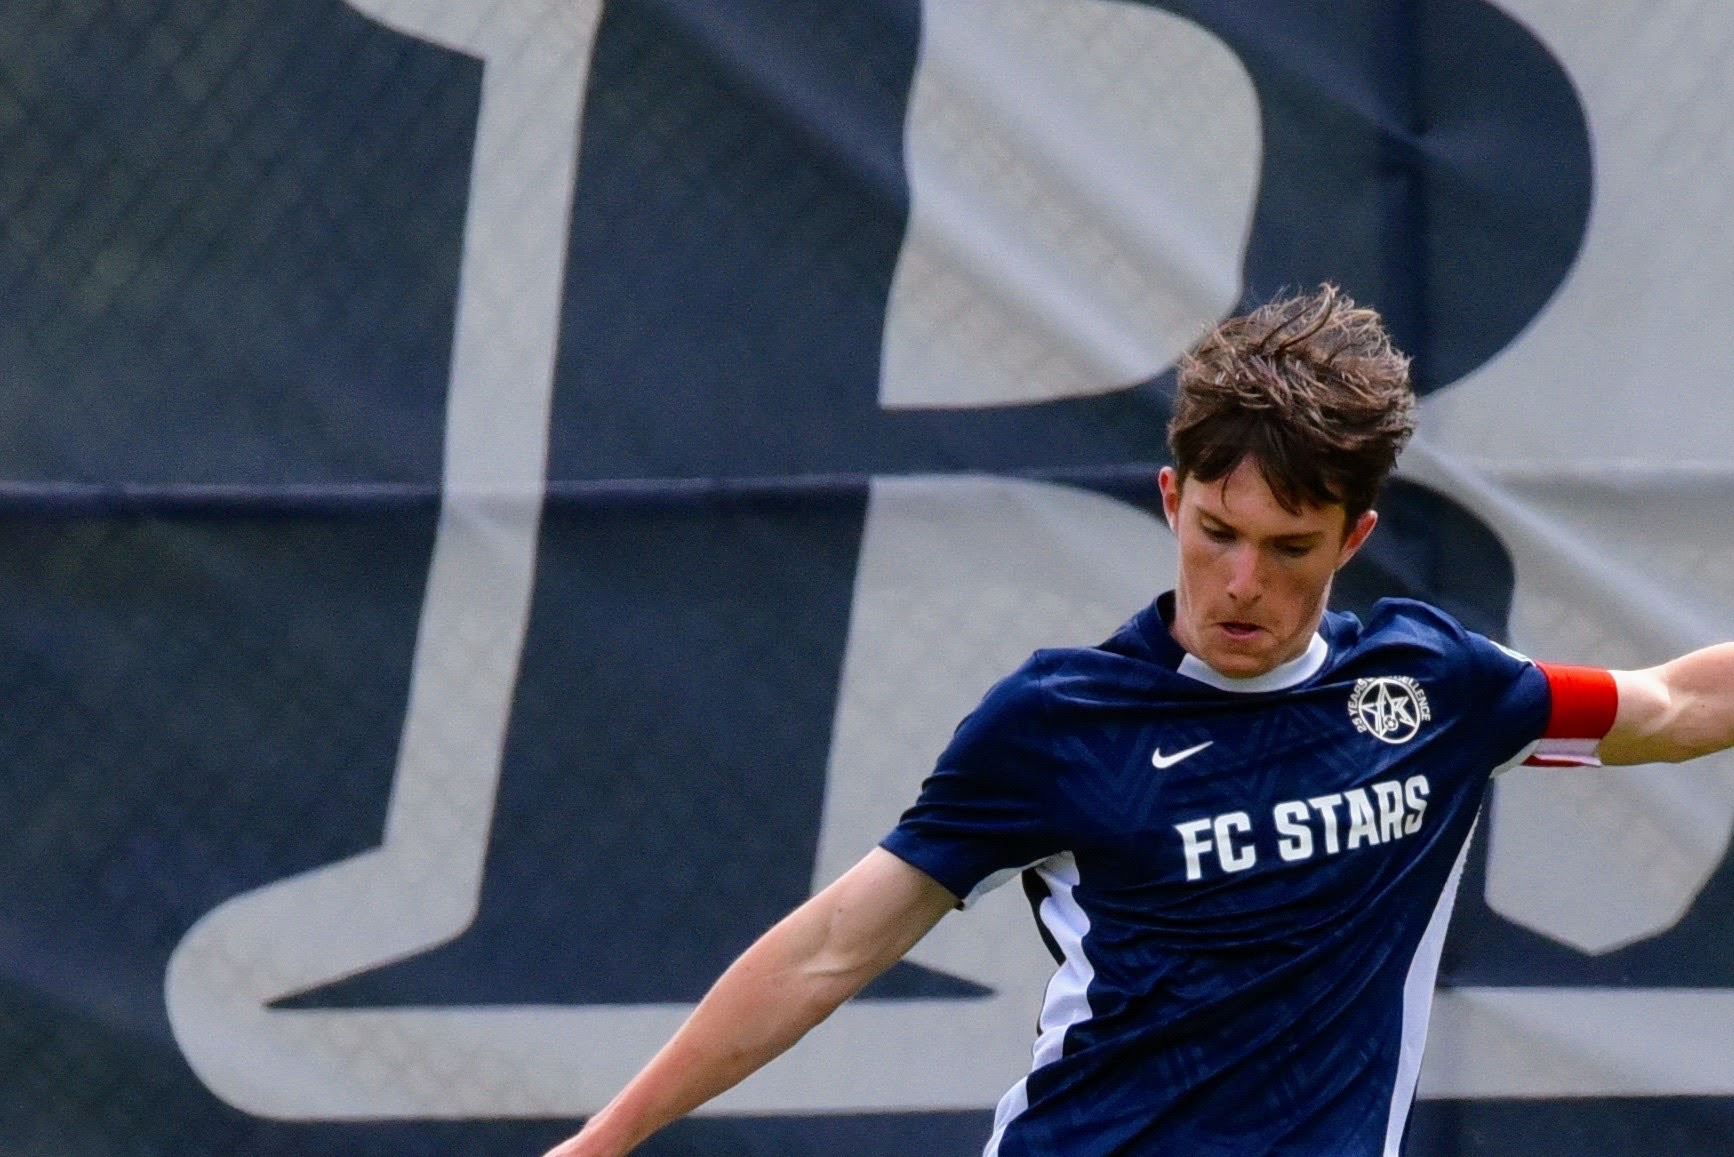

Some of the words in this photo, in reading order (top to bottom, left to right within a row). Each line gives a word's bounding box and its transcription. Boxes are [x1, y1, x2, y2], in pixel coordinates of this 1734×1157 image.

[1347, 678, 1368, 716] YEARS
[1171, 810, 1257, 882] FC
[1272, 773, 1431, 862] STARS
